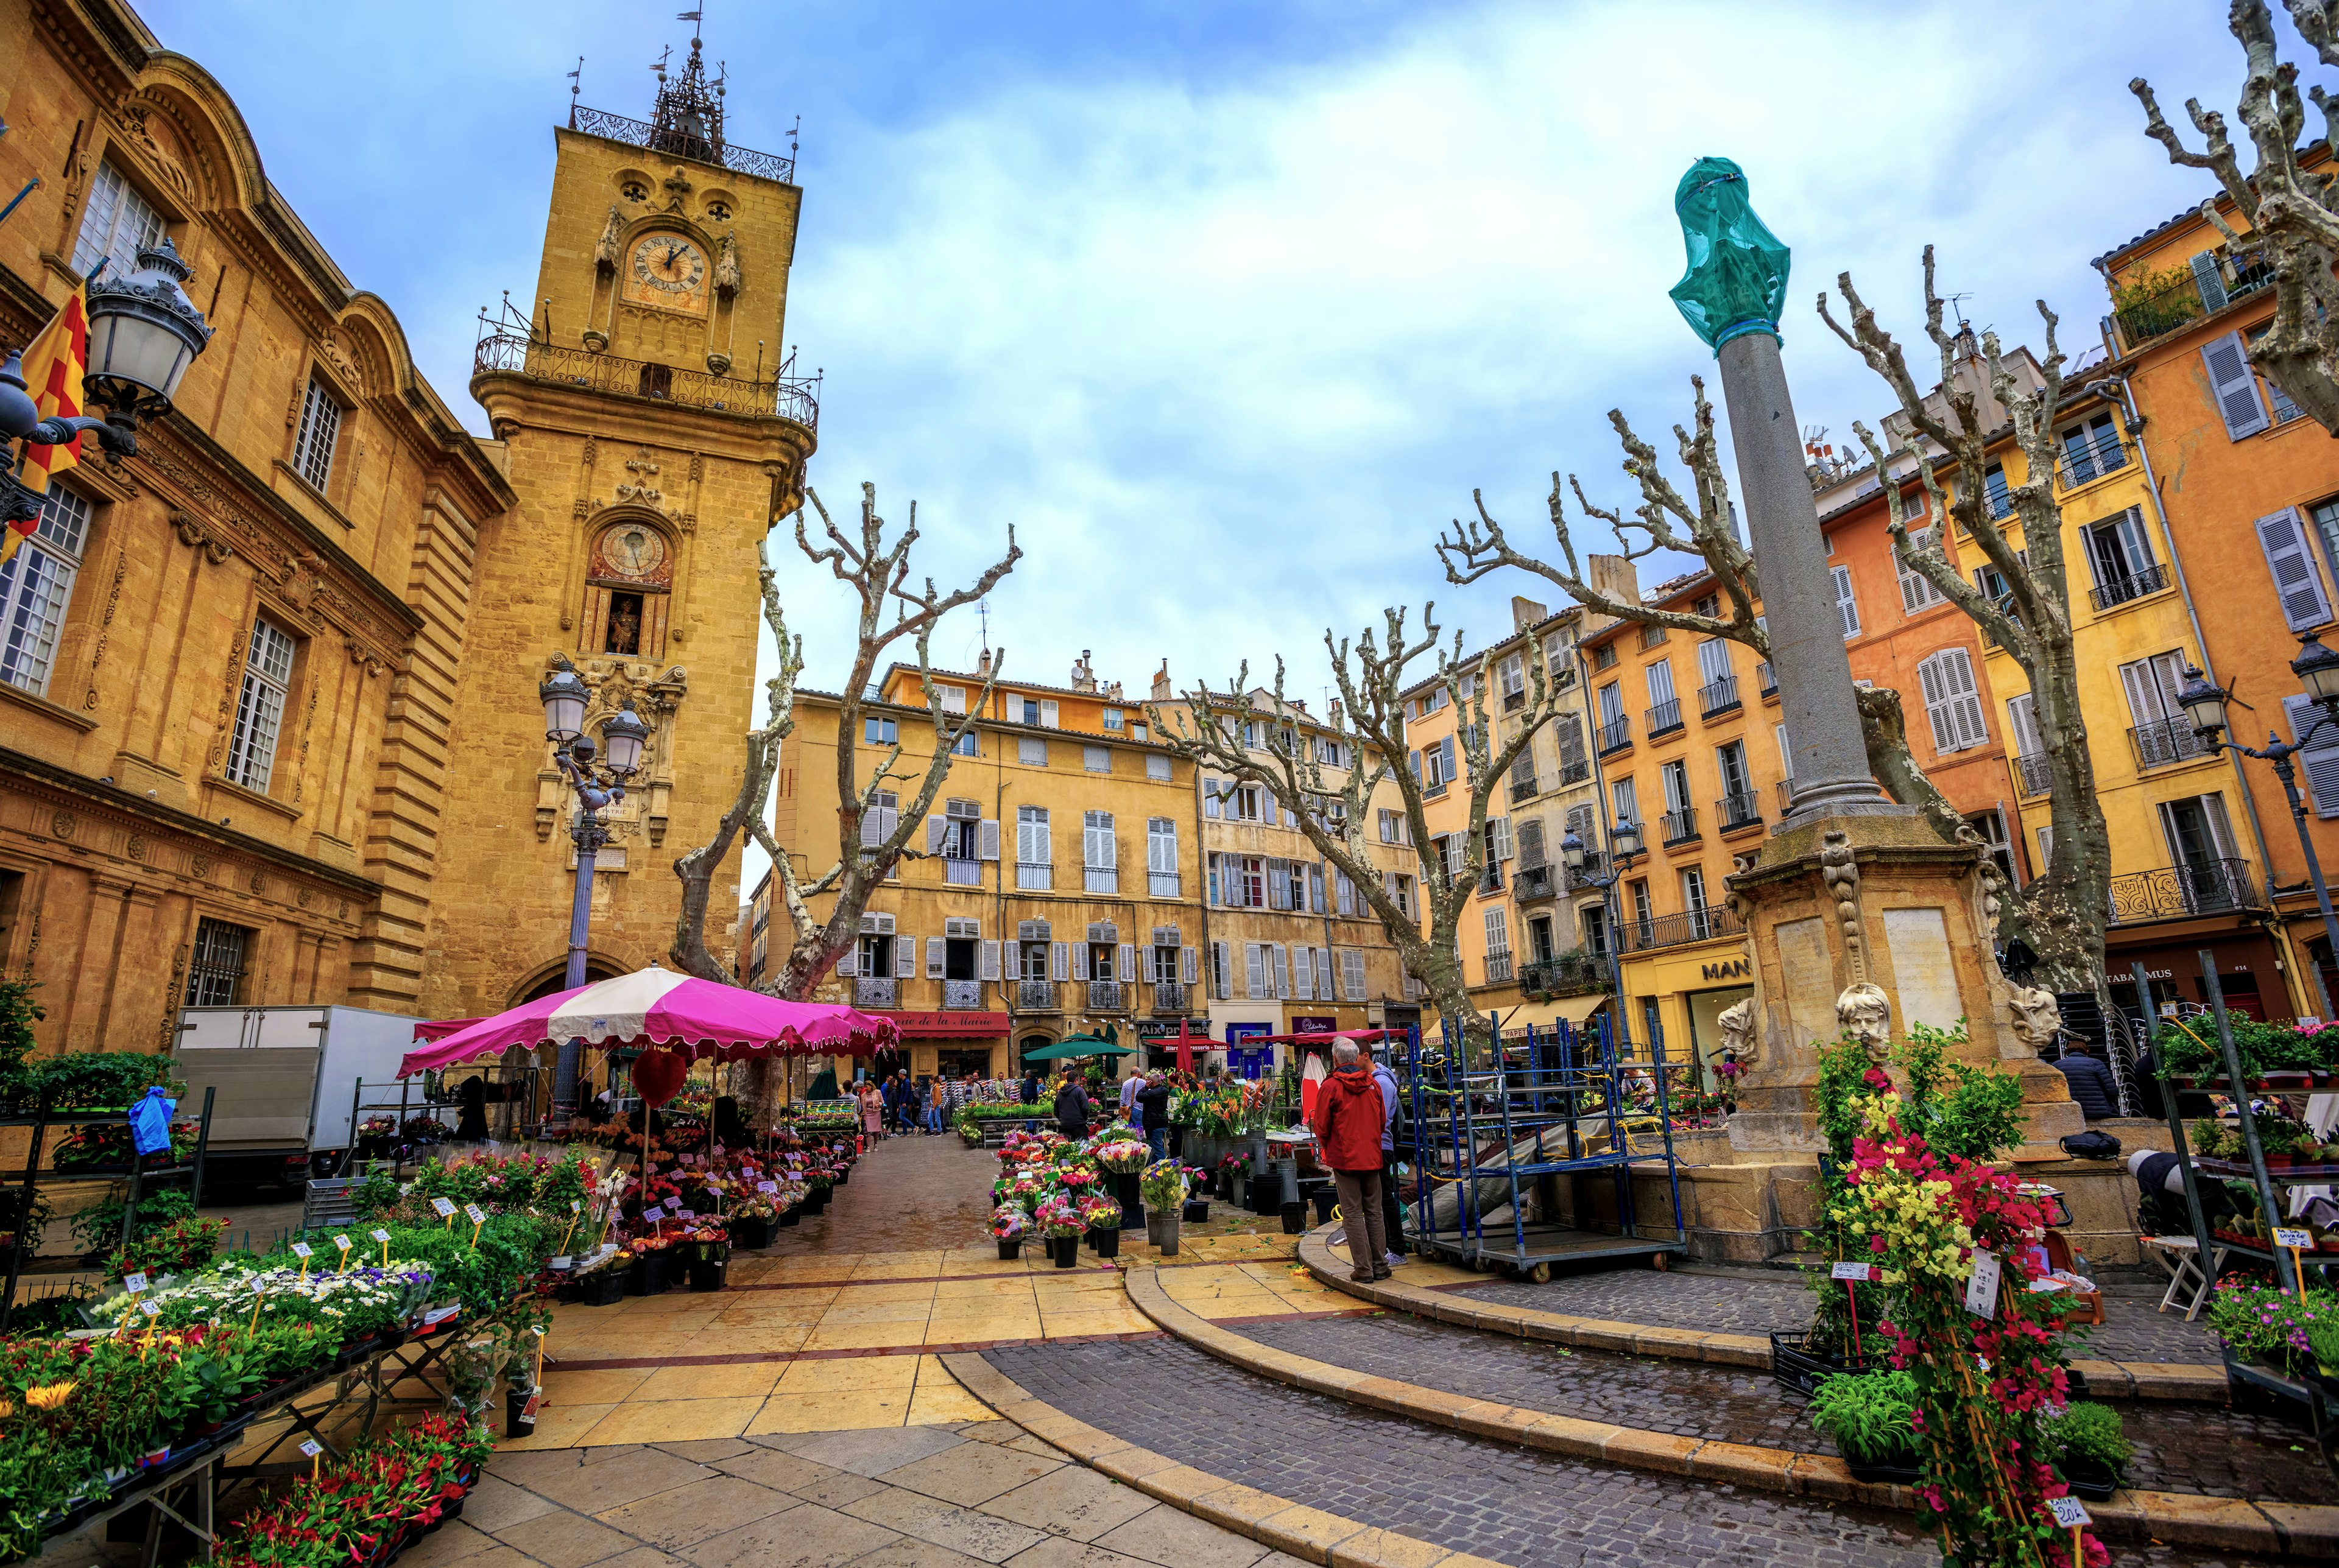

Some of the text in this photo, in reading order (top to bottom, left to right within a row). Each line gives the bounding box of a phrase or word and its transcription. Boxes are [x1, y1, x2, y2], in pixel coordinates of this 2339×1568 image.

[2106, 969, 2172, 983] TABAMUS
[895, 1014, 992, 1025] erie de la Mairie
[1140, 1025, 1209, 1036] Aixprsso
